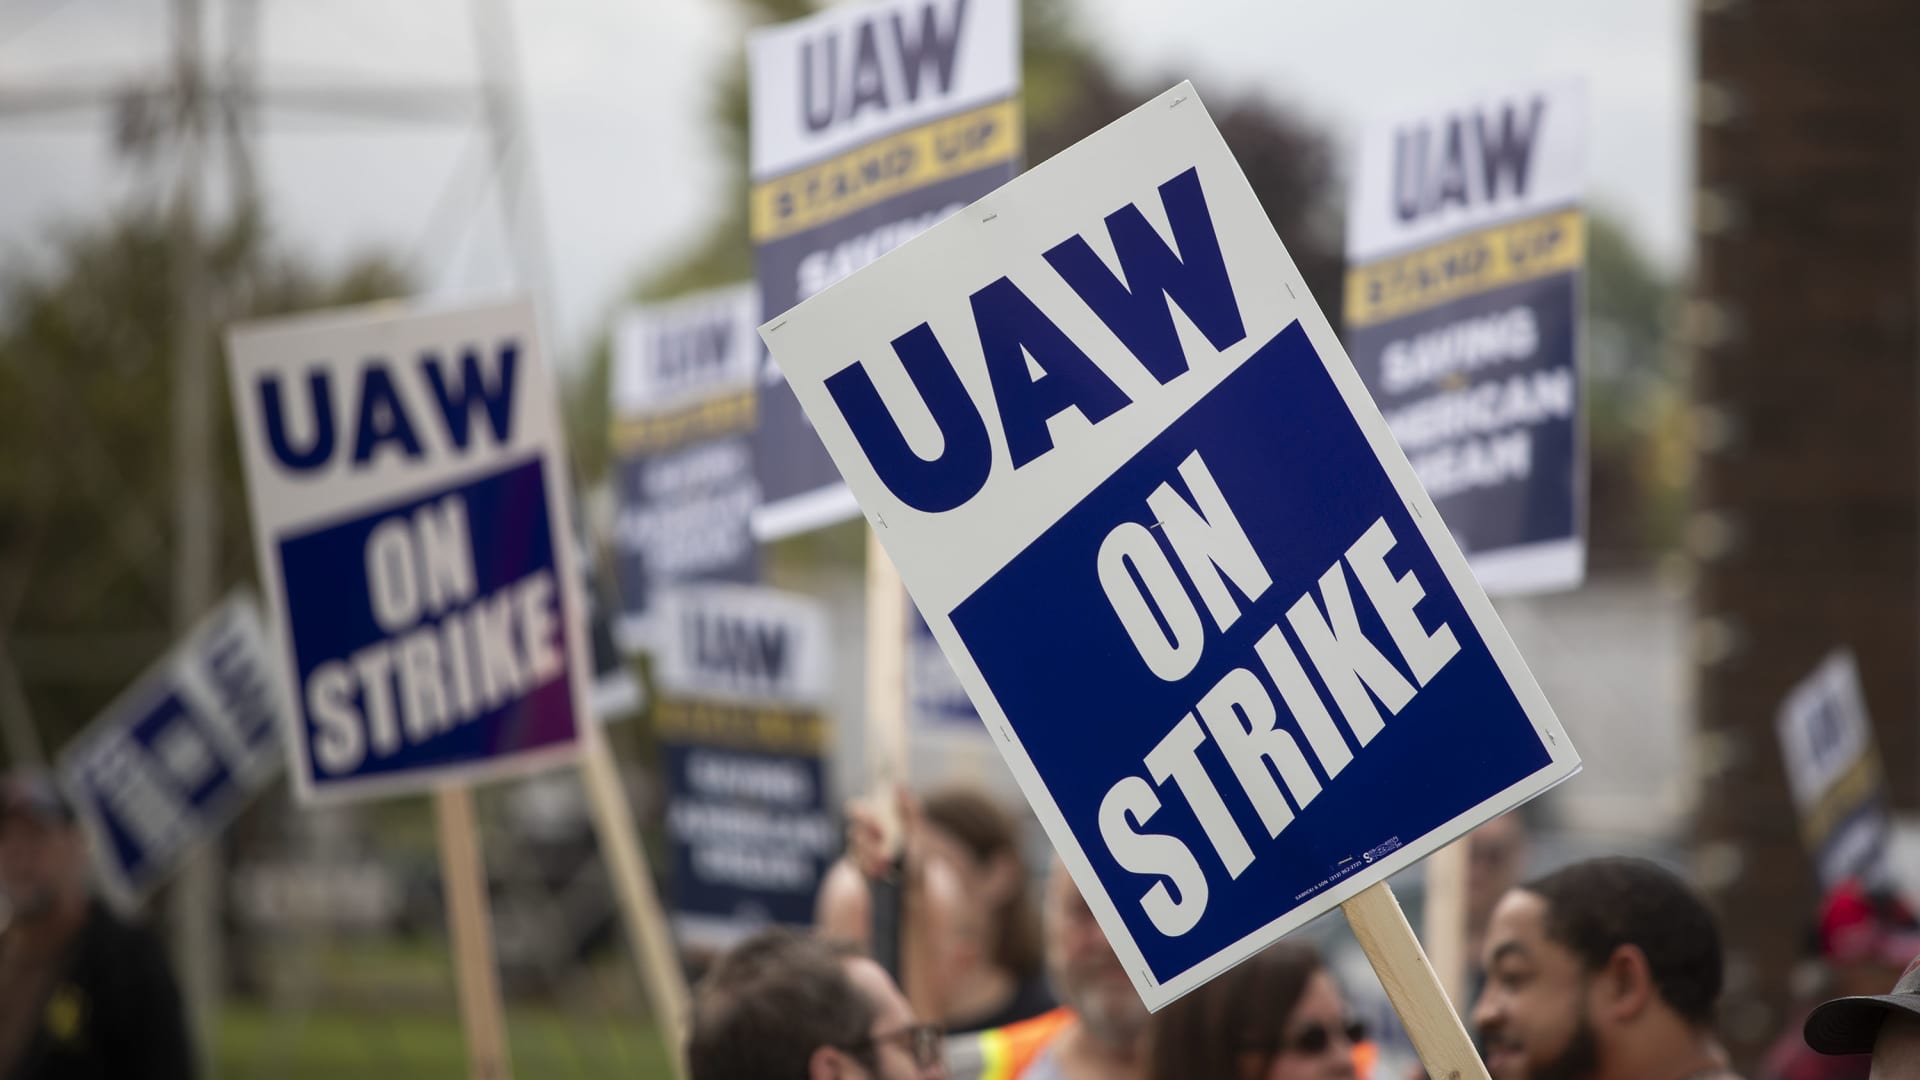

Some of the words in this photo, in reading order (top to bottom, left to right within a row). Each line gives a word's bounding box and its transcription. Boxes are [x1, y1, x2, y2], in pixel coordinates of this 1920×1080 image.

[801, 0, 966, 134] UAW
[775, 142, 917, 221] STAND
[932, 120, 995, 164] UP
[1391, 94, 1546, 222] UAW
[823, 166, 1248, 514] UAW
[1380, 305, 1538, 394] SAVING
[255, 341, 520, 479] UAW
[364, 496, 474, 632] ON
[1096, 448, 1274, 682] ON
[305, 575, 564, 774] STRIKE
[680, 610, 791, 682] UAW
[1097, 515, 1462, 937] STRIKE
